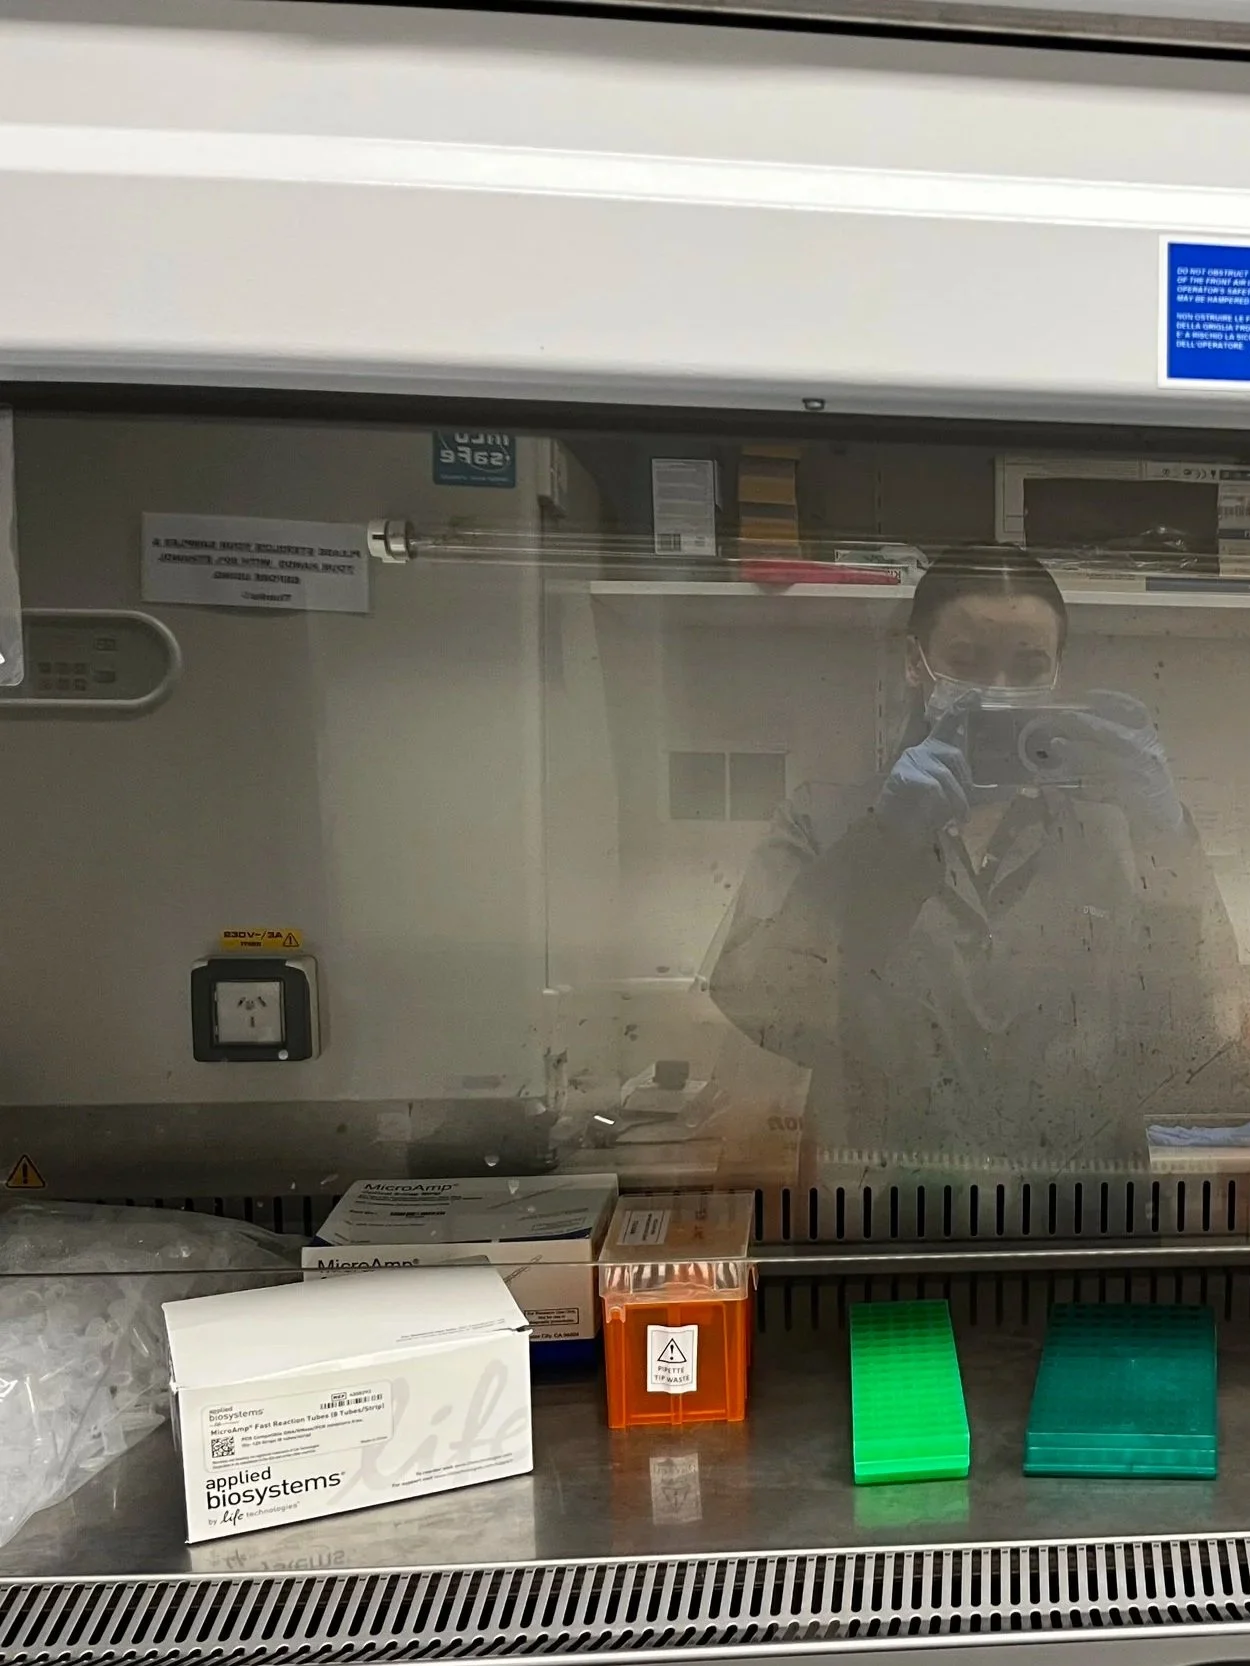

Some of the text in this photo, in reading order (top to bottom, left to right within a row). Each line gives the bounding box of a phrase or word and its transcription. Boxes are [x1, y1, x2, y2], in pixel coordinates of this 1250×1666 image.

[1190, 267, 1206, 276] NOT
[1208, 268, 1249, 278] OBSTRUCT
[1190, 276, 1204, 285] THE
[1205, 277, 1232, 286] FRONT
[1233, 279, 1247, 287] AIR
[1177, 295, 1193, 303] MAY
[1195, 295, 1206, 304] BE
[1234, 315, 1244, 324] LE
[1176, 322, 1201, 330] DELLA
[1225, 333, 1235, 341] LA
[657, 1365, 685, 1375] PIPETTE
[654, 1374, 690, 1383] TIP WASTE
[209, 1406, 233, 1415] applied
[254, 1422, 271, 1430] Fast
[272, 1416, 306, 1427] Reaction
[307, 1413, 329, 1421] Tubes
[206, 1466, 272, 1492] applied
[208, 1518, 218, 1527] by
[220, 1508, 244, 1527] life
